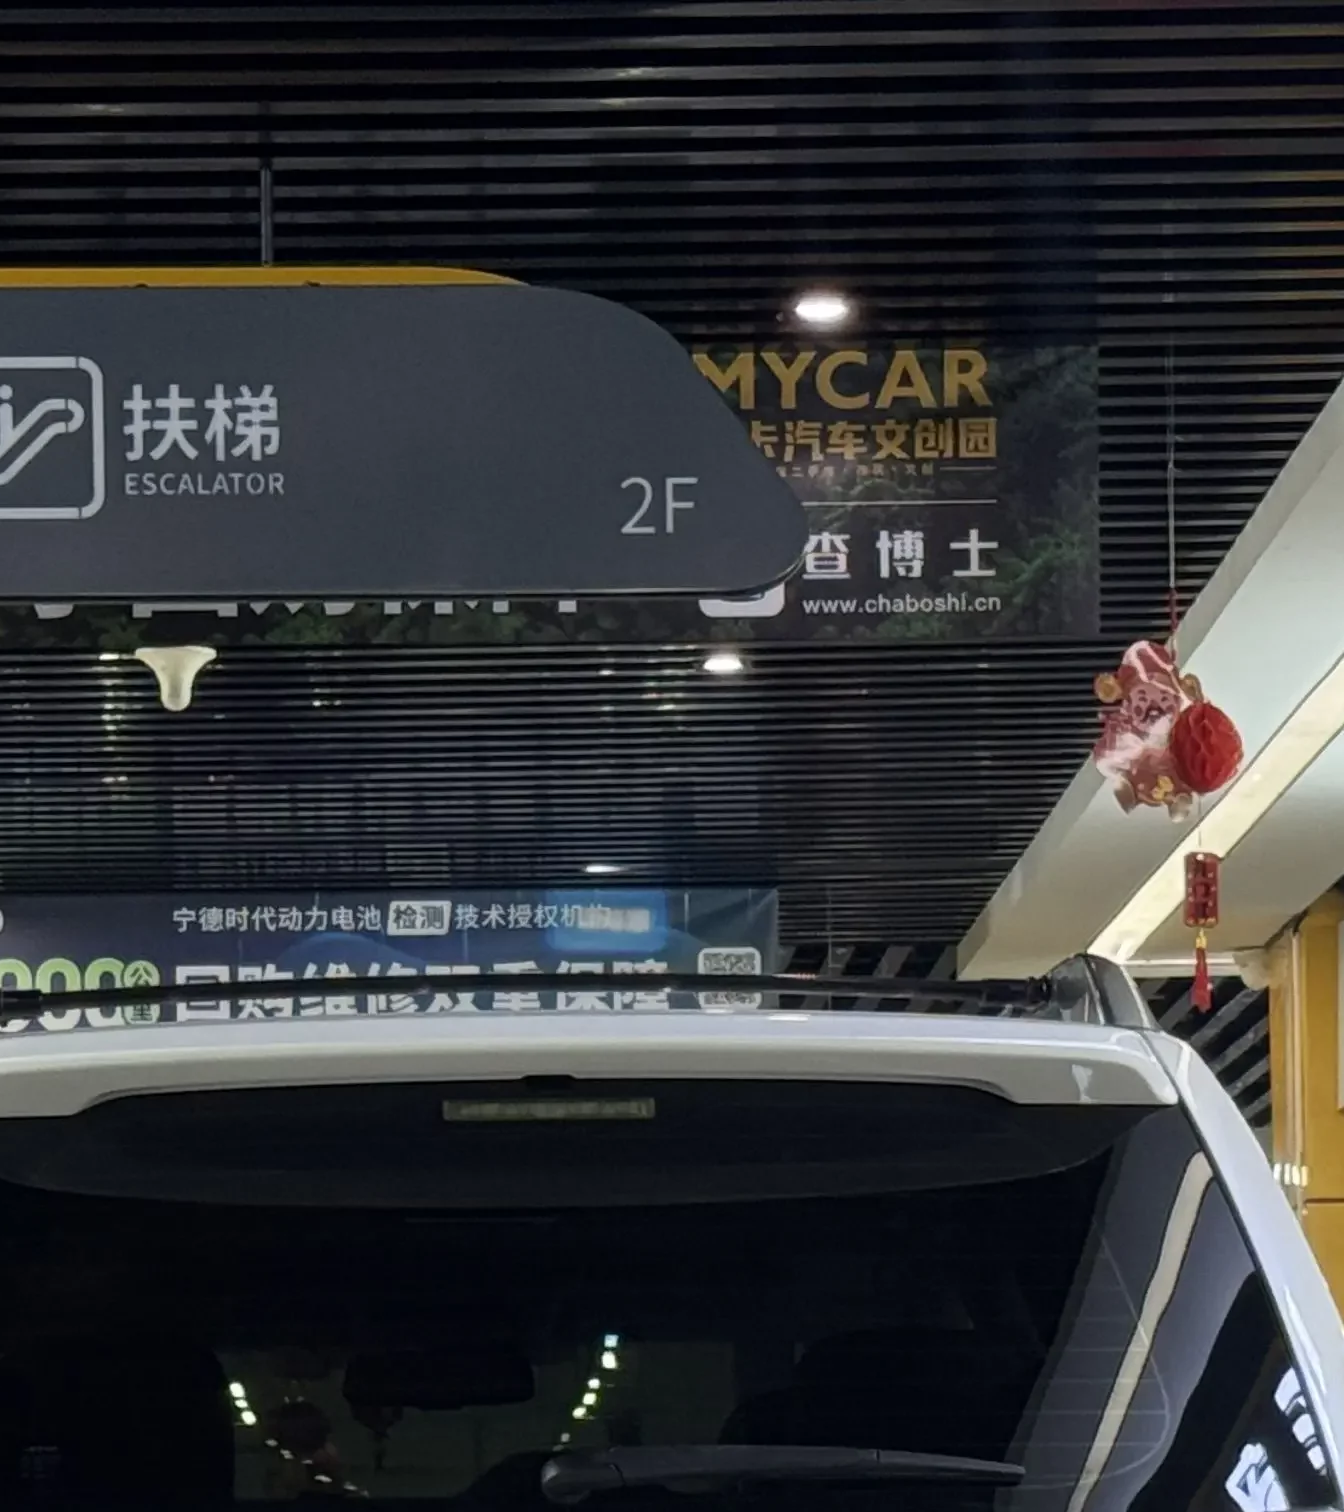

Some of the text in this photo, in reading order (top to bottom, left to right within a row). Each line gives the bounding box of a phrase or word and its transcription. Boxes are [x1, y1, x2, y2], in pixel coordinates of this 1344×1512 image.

[692, 349, 994, 410] MYCAR
[123, 383, 282, 463] 扶梯
[123, 472, 286, 497] ESCALATOR
[619, 476, 699, 535] 2F
[802, 528, 1000, 581] 查博士
[802, 593, 1003, 616] www.chaboshi.cn
[172, 905, 383, 933] 宁德时代动力电池
[392, 904, 445, 931] 检测
